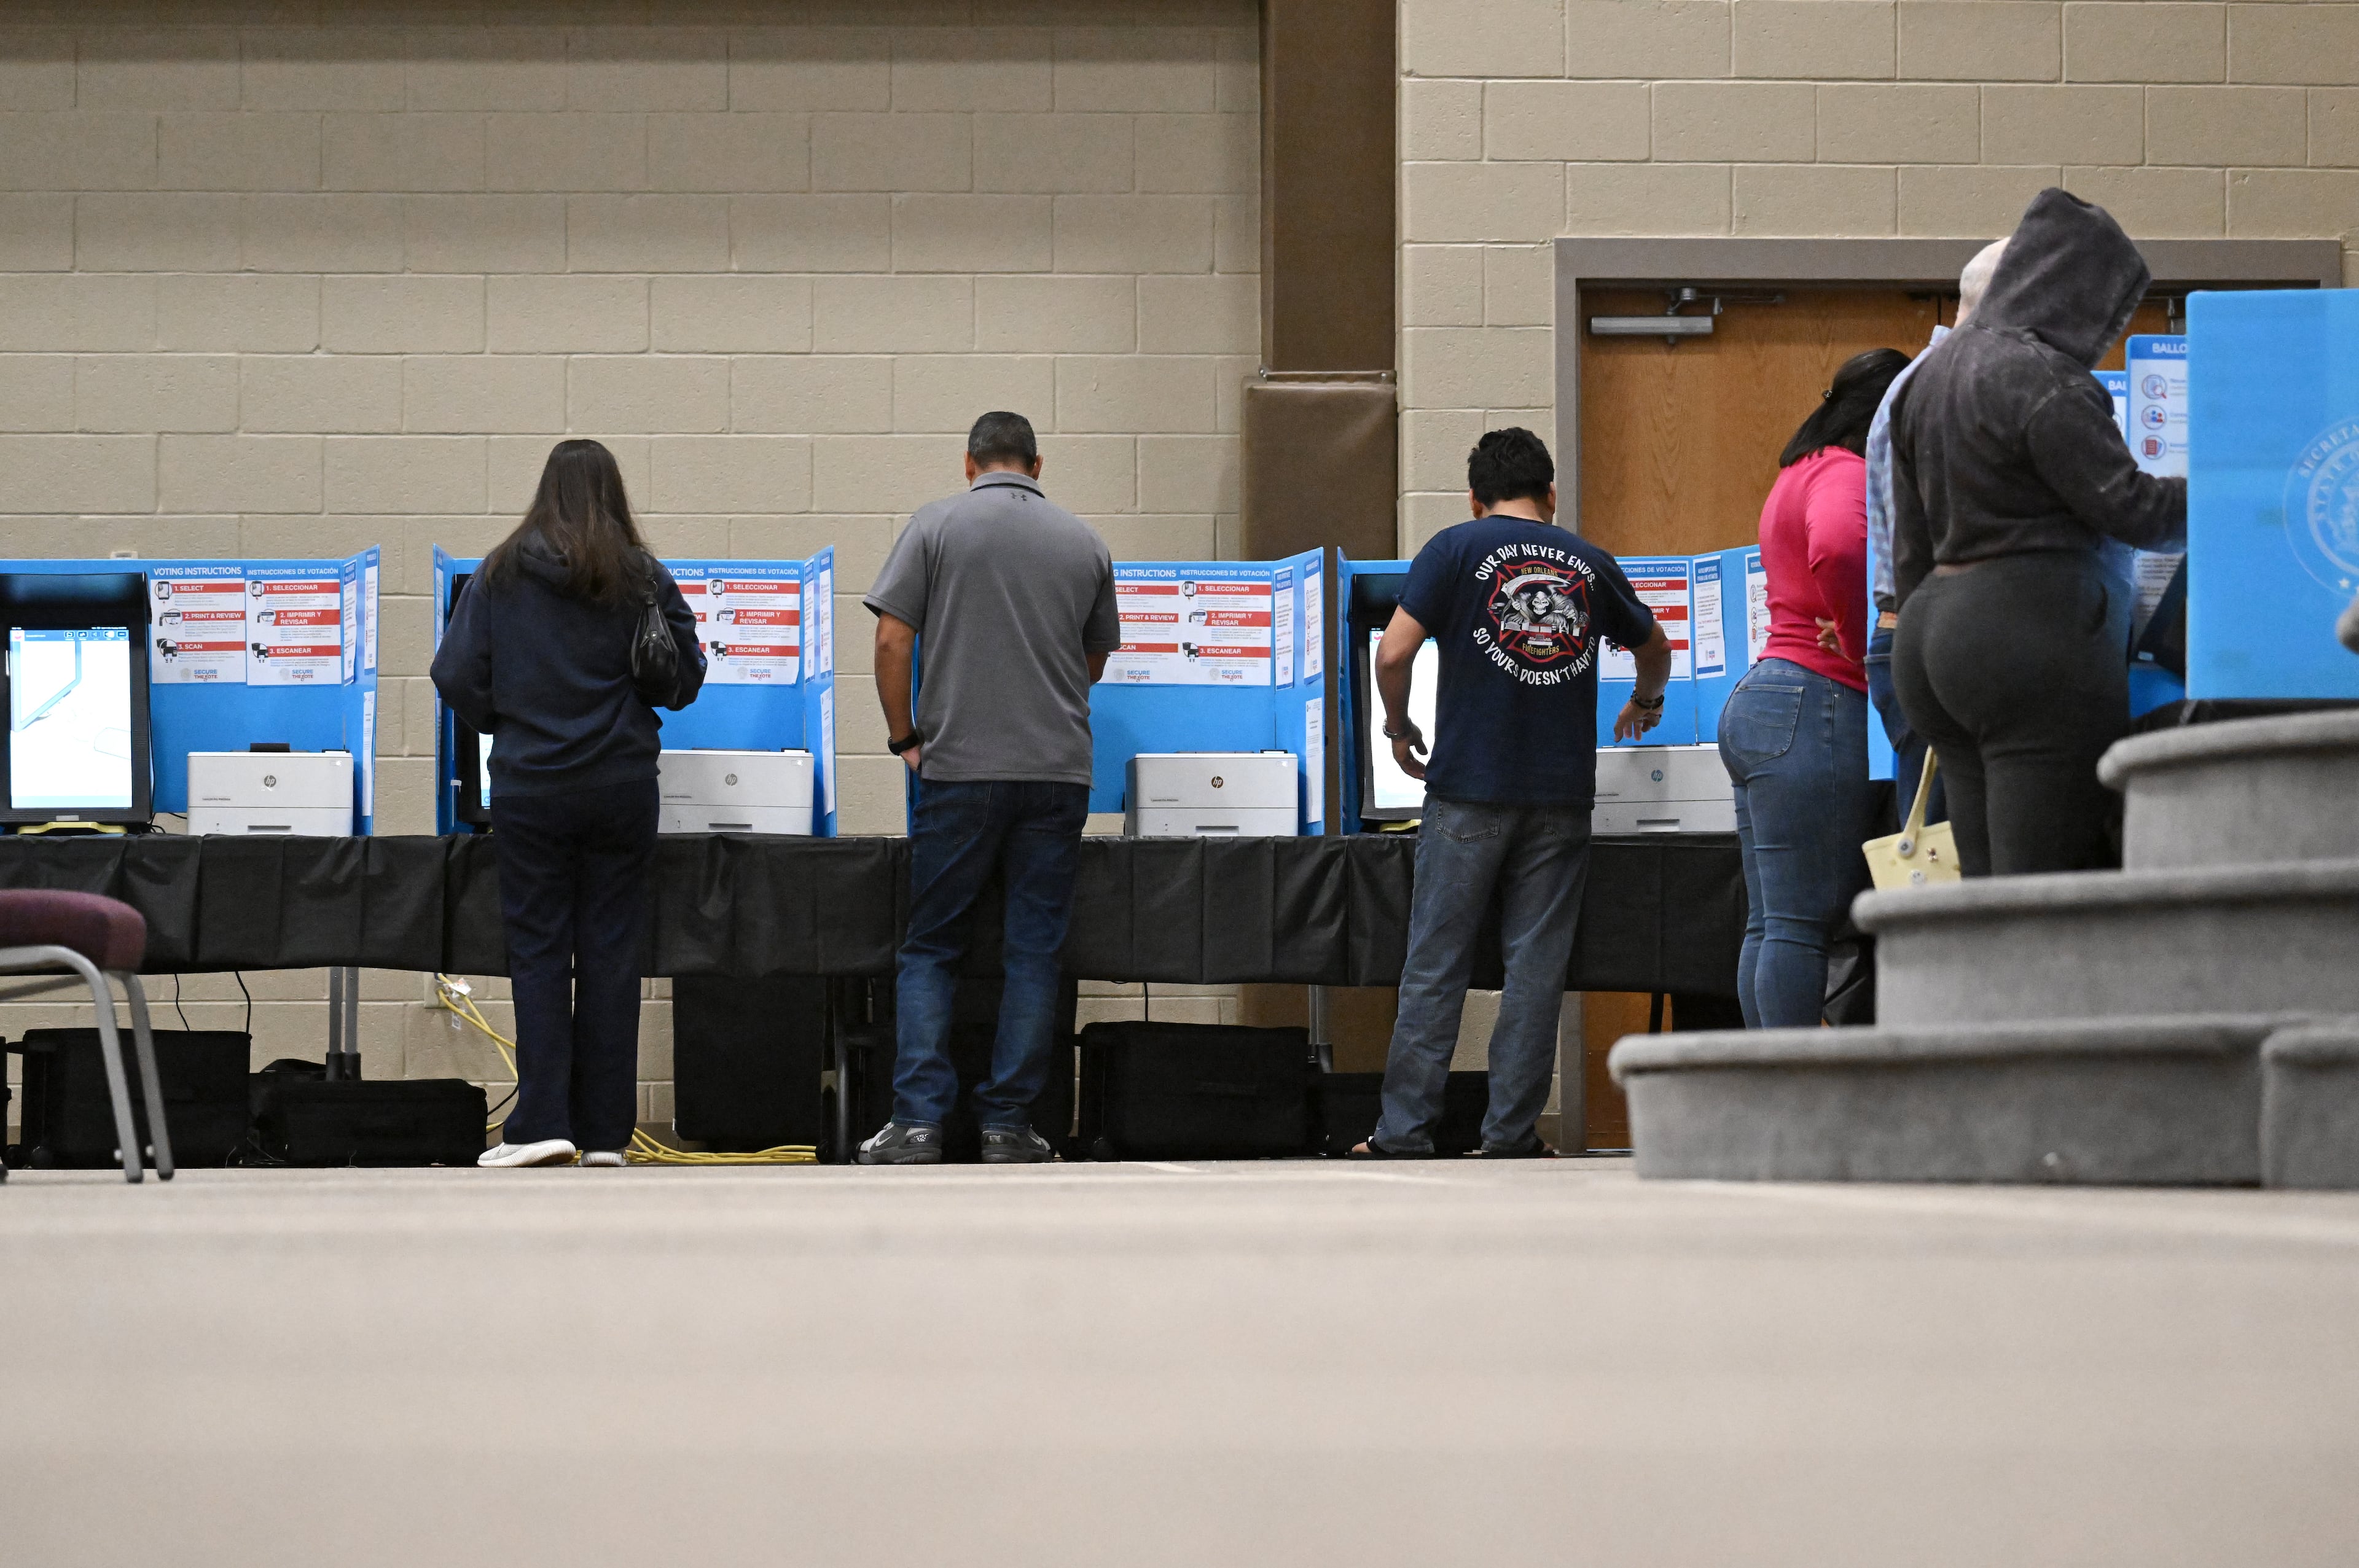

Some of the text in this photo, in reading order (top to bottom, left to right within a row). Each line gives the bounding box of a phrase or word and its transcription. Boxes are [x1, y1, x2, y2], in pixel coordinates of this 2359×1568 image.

[2152, 343, 2188, 354] BALLO
[1475, 544, 1595, 591] OUR DAY NEVER ENDS...
[1533, 567, 1558, 577] ORLEANS
[1522, 643, 1560, 655] FIREFIGHTERS
[1473, 627, 1490, 644] SO
[1485, 641, 1519, 677] YOURS
[1519, 666, 1570, 685] DOESN'T
[1588, 636, 1595, 653] TO
[264, 775, 276, 787] hp
[725, 773, 737, 786] hp
[1211, 776, 1224, 789] hp
